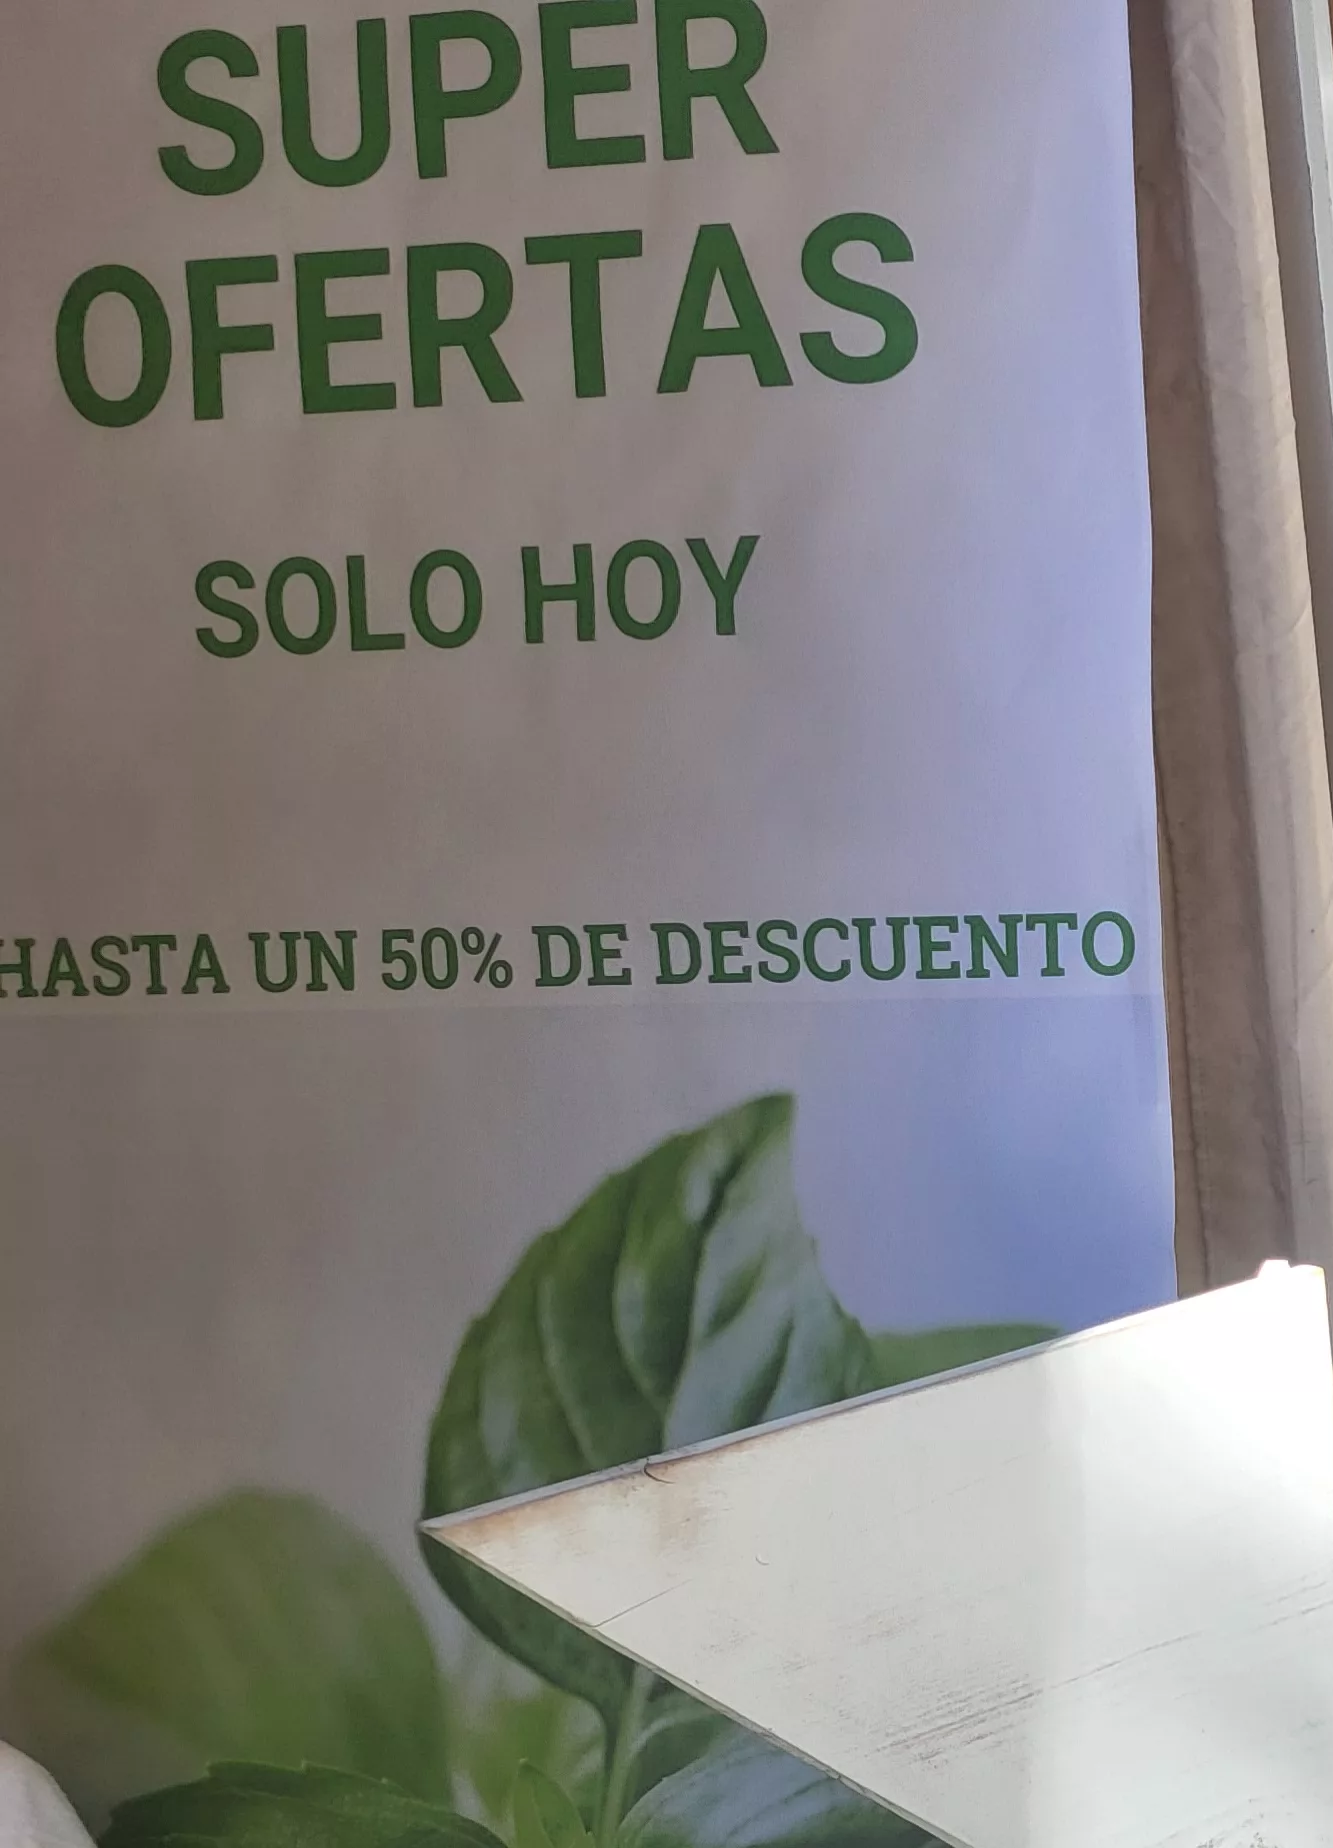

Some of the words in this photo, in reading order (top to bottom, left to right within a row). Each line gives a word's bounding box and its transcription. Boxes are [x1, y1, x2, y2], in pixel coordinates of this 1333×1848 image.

[157, 0, 780, 196] SUPER
[55, 212, 919, 429] OFERTAS
[194, 548, 486, 659] SOLO
[521, 535, 760, 645] HOY
[0, 934, 230, 998] HASTA
[252, 931, 357, 993] UN
[380, 926, 513, 990] 50%
[533, 925, 632, 988] DE
[652, 910, 1136, 985] DESCUENTO
